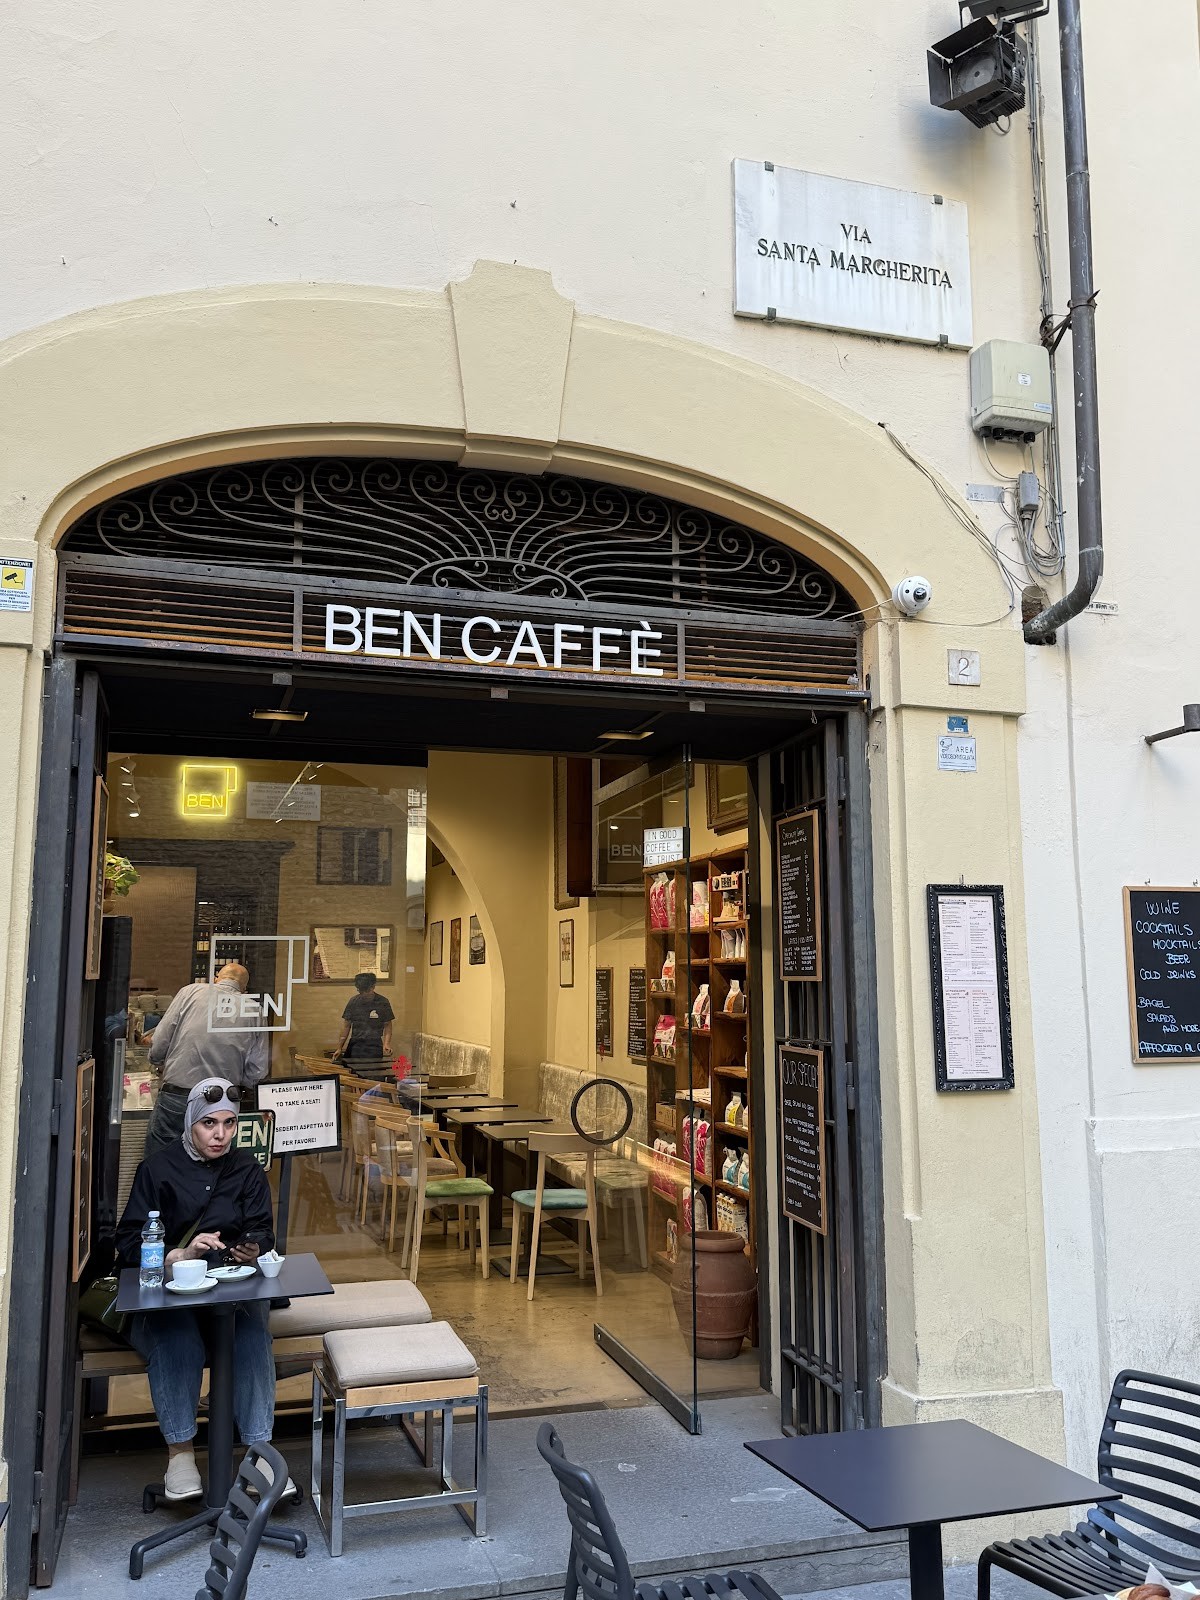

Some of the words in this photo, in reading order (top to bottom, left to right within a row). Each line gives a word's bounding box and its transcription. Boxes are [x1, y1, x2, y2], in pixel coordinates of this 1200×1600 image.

[840, 223, 872, 244] VIA
[757, 238, 821, 266] SANTA
[829, 249, 953, 289] MARGHERITA
[324, 603, 442, 660] BEN
[460, 614, 664, 676] CAFFÈ
[958, 657, 971, 677] 2
[955, 746, 974, 754] AREA
[187, 793, 224, 808] BEN
[648, 831, 657, 840] IN
[611, 844, 642, 857] BEN
[645, 842, 671, 853] COFFEE
[1145, 899, 1180, 915] WINE
[1135, 920, 1194, 936] COCKTAILS
[1165, 952, 1191, 965] BEER
[1139, 967, 1161, 980] COLD
[1166, 969, 1197, 979] DRINKS
[216, 993, 284, 1018] BEN
[1137, 996, 1171, 1009] BAGEL
[1146, 1012, 1177, 1024] SALADS
[1162, 1024, 1180, 1033] AND
[1139, 1041, 1183, 1053] AFFOGATO
[1184, 1043, 1196, 1053] AL
[782, 1058, 798, 1085] OUR
[271, 1086, 293, 1094] PLEASE
[232, 1121, 269, 1148] EN
